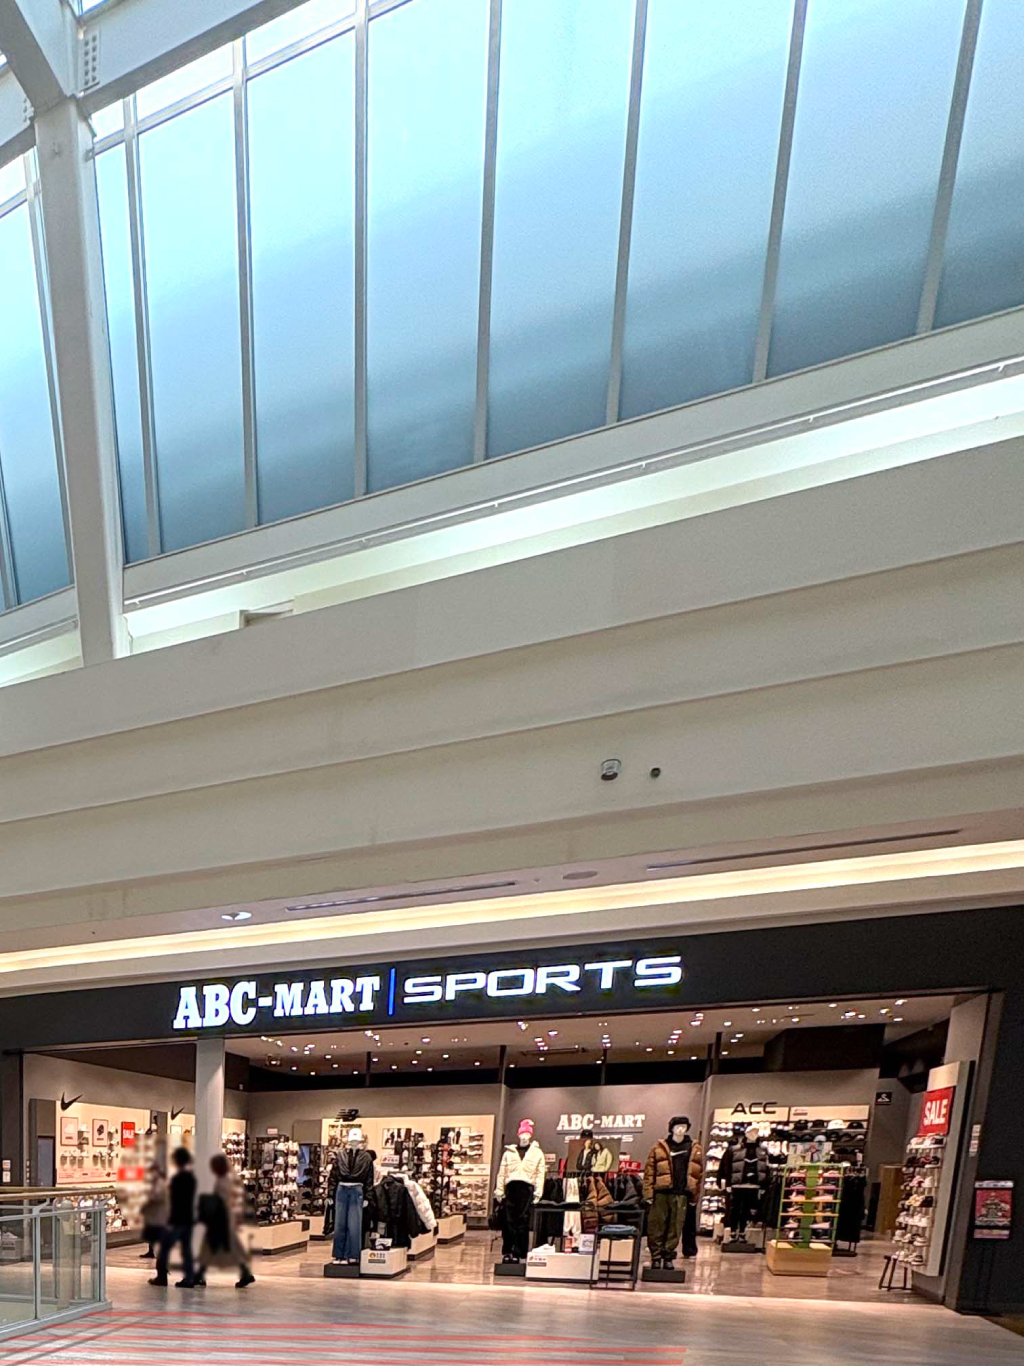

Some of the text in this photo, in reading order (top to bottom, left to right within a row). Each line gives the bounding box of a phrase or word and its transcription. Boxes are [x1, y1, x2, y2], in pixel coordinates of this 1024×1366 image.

[173, 956, 682, 1029] ABC-MART SPORTS
[731, 1102, 777, 1115] ACC
[923, 1098, 948, 1126] SALE
[556, 1114, 645, 1131] ABC-MART
